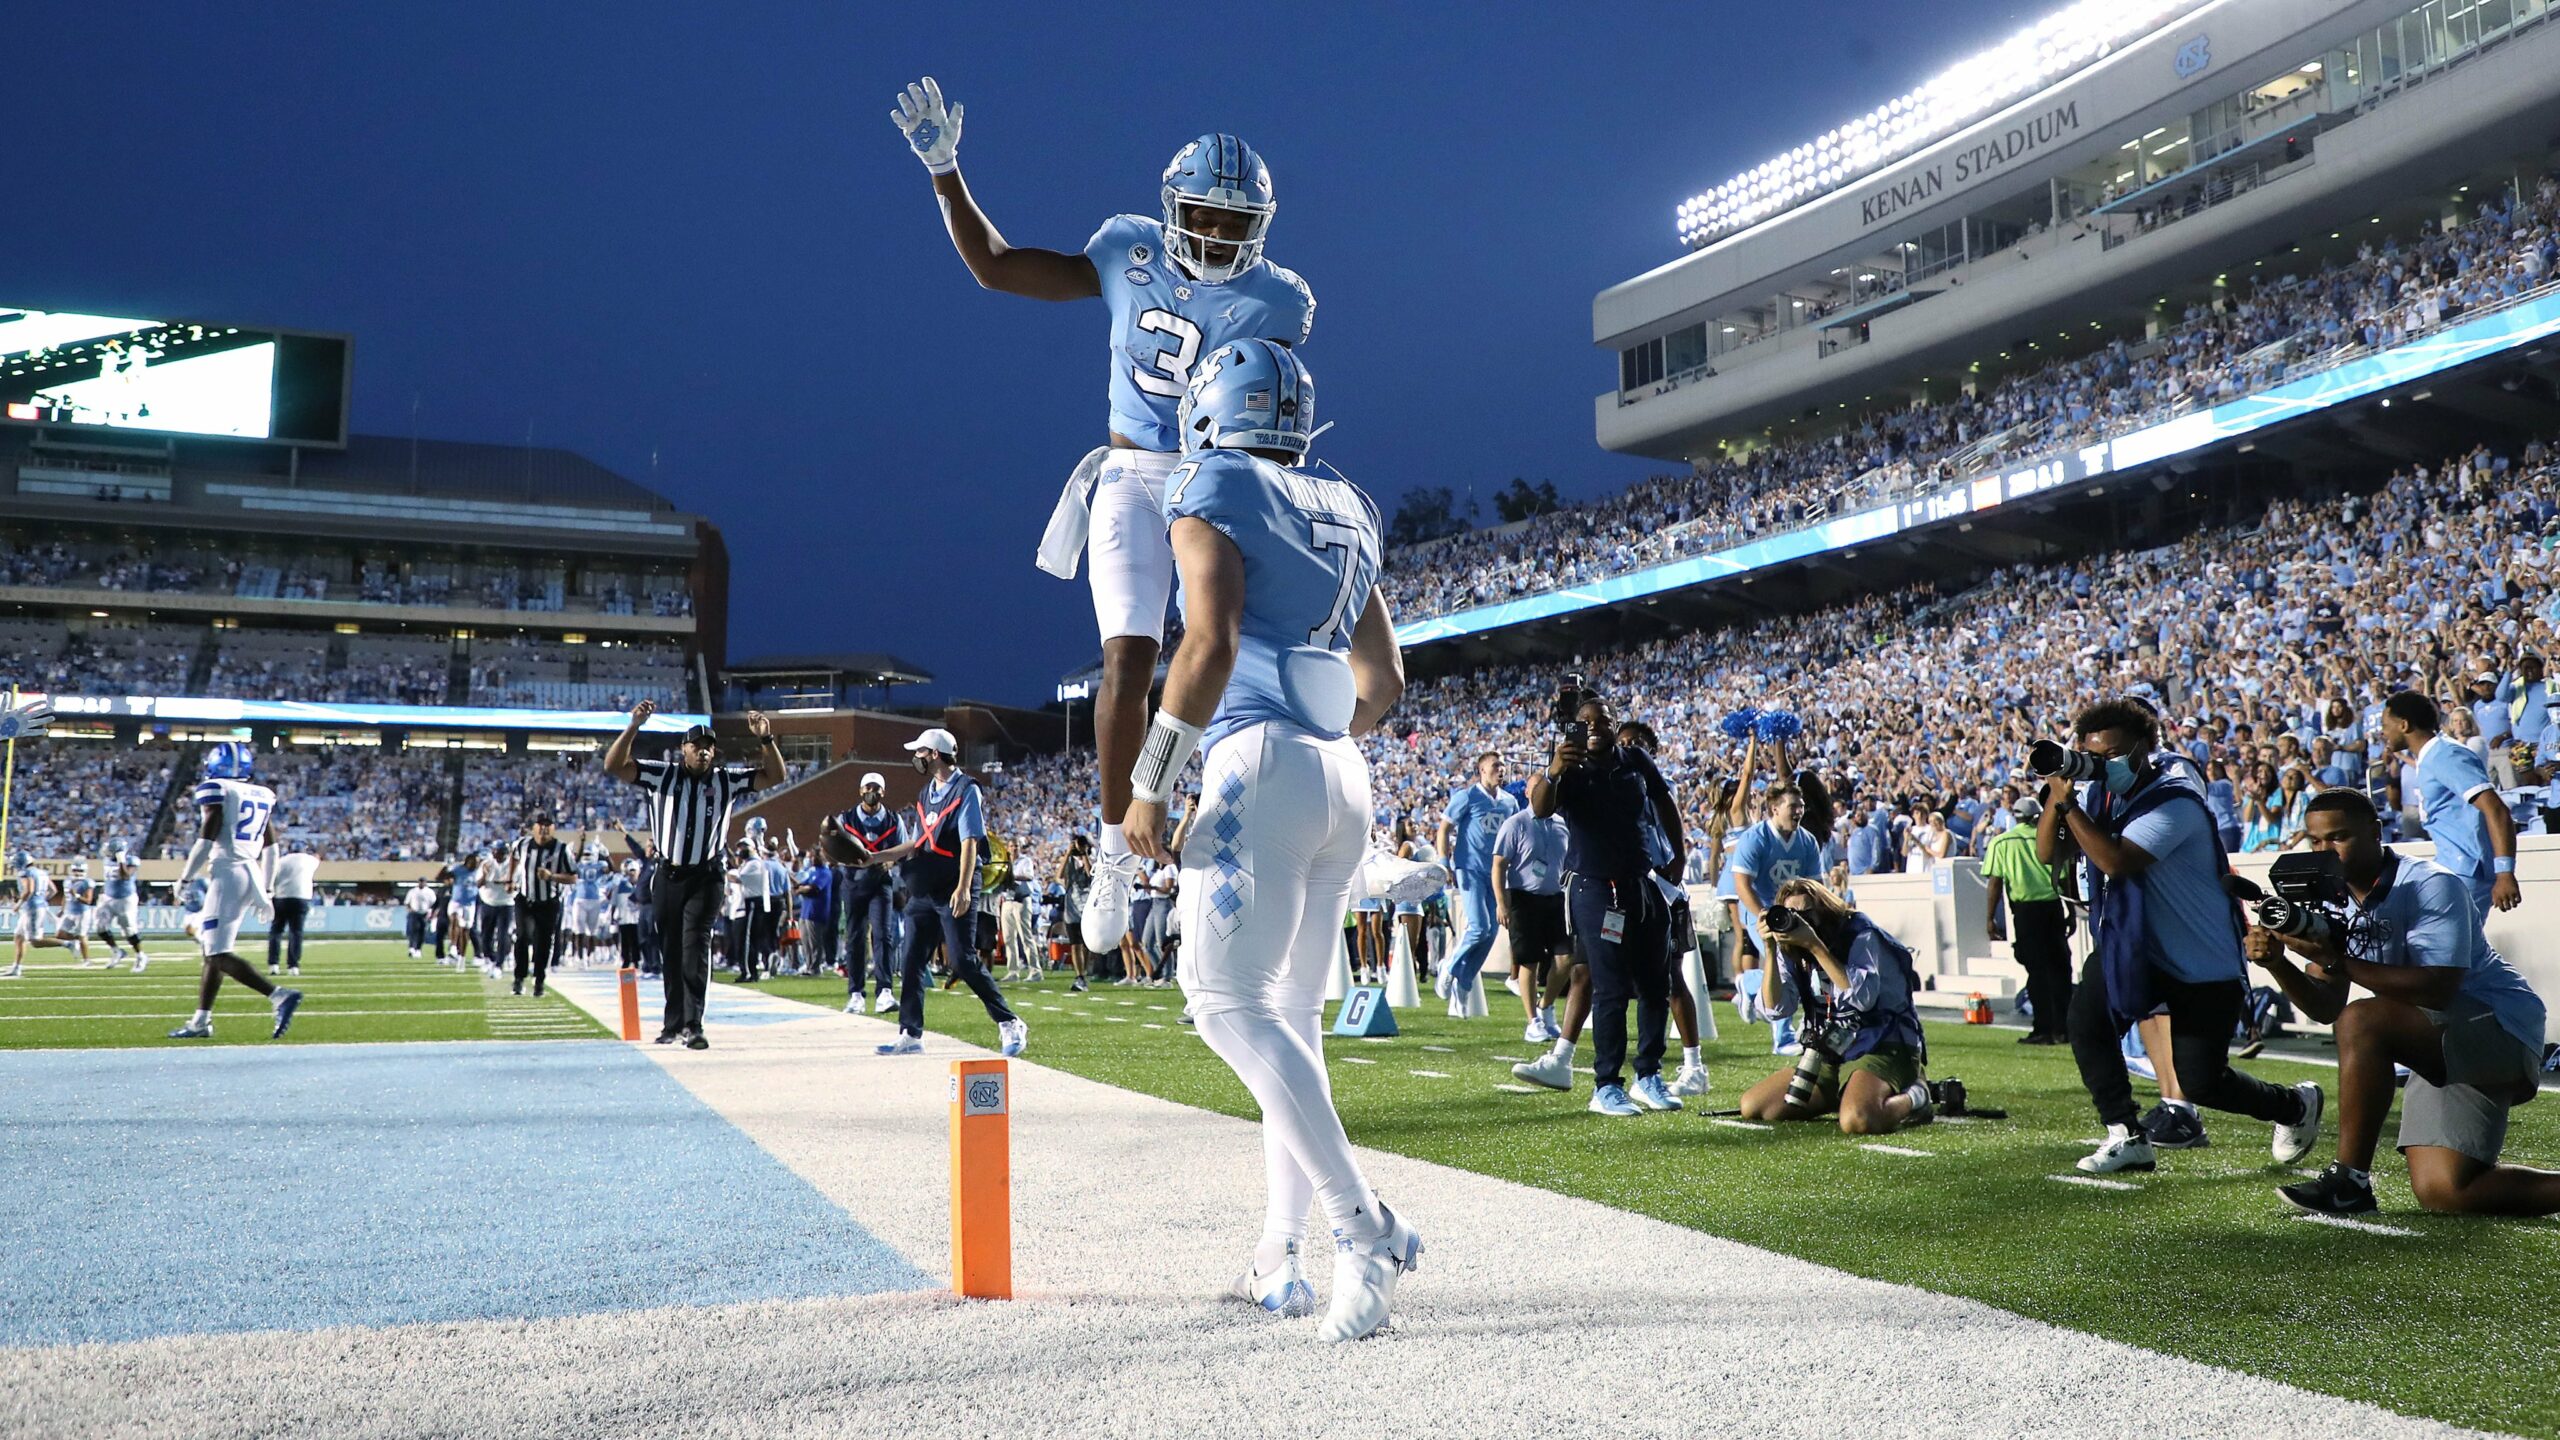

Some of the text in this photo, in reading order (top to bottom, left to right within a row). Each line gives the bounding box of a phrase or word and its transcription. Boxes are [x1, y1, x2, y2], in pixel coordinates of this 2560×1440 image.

[1861, 101, 2081, 226] KENAN STADIUM
[1127, 270, 1150, 281] ACC
[1131, 306, 1204, 399] 3
[1255, 433, 1280, 445] TAR
[1168, 460, 1203, 504] 7
[1309, 518, 1362, 651] 7
[235, 800, 269, 841] 27
[706, 806, 713, 816] S
[1346, 990, 1370, 1026] G
